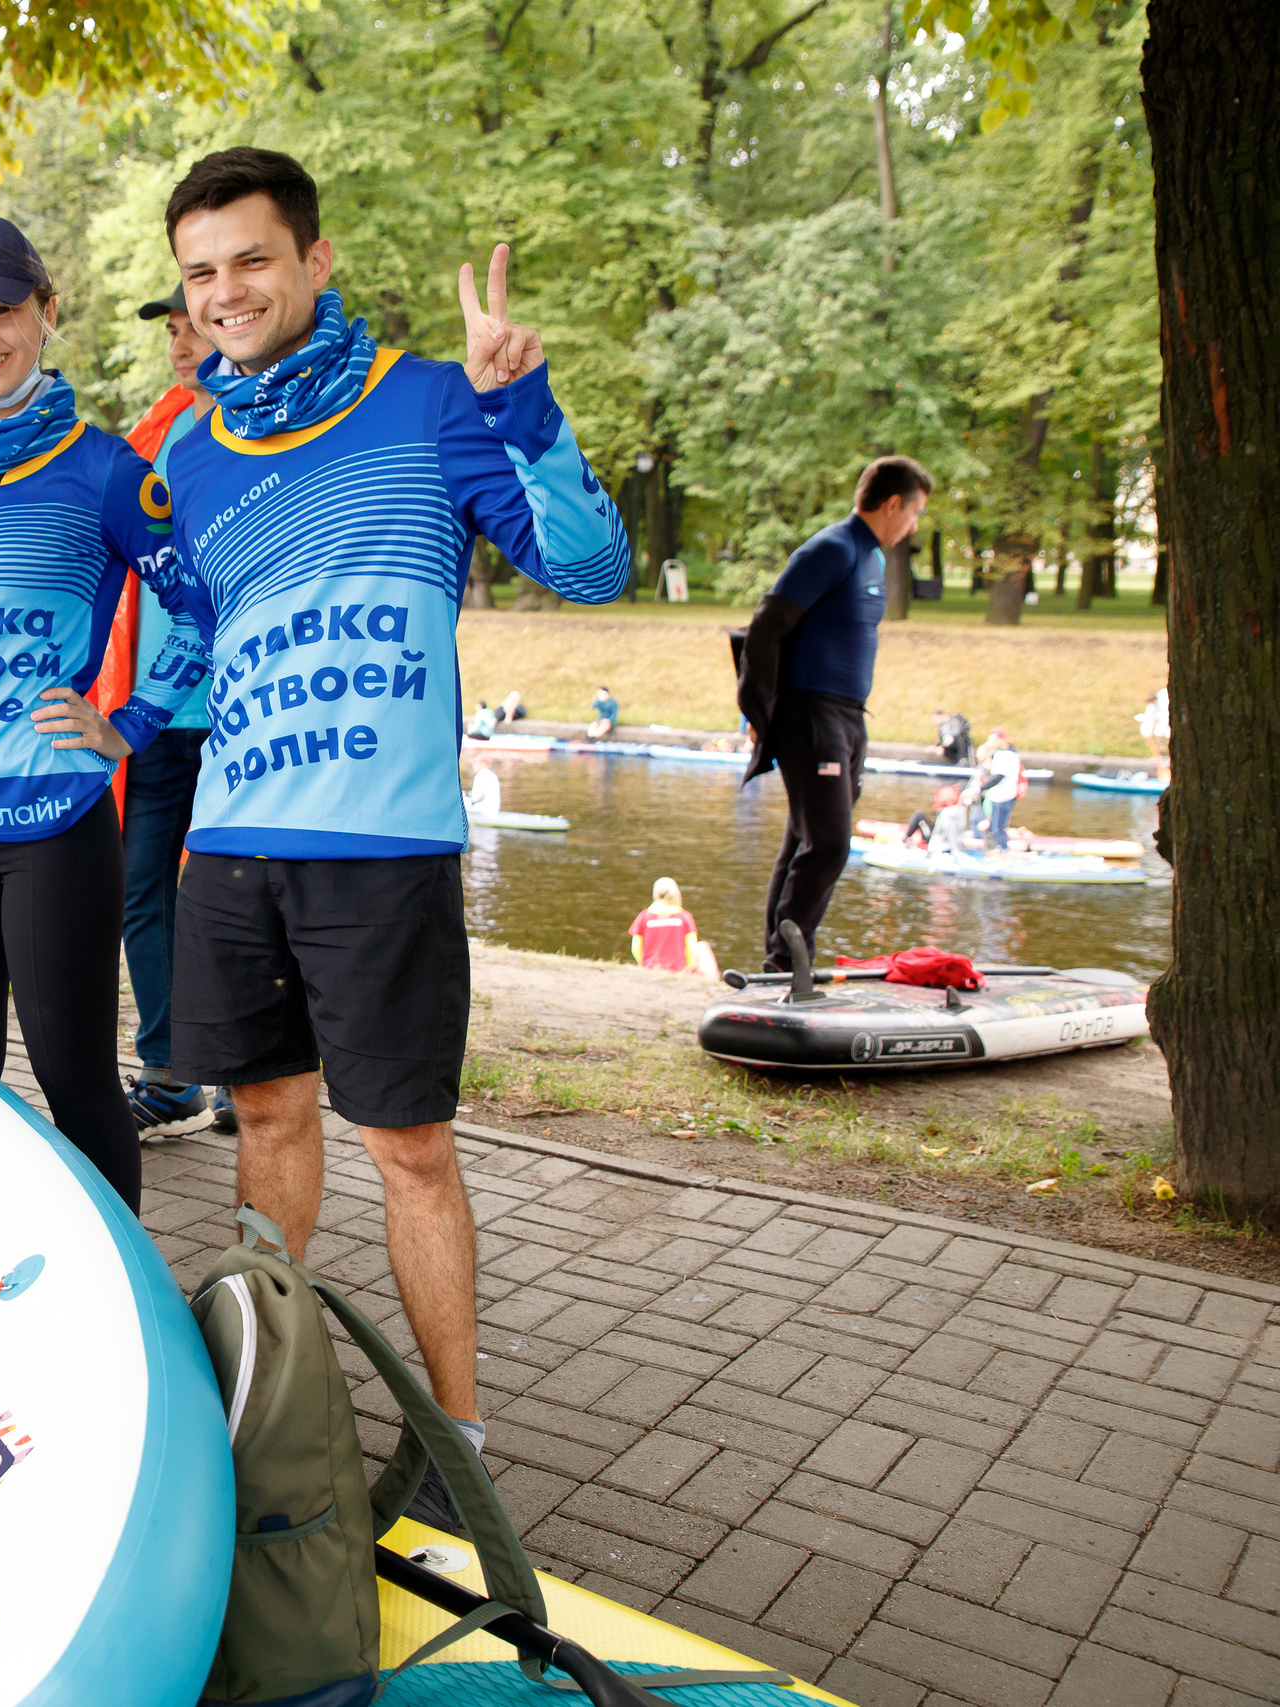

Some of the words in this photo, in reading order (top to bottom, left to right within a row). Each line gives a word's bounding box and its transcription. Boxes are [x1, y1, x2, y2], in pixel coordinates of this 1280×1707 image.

[208, 697, 251, 758] на
[251, 649, 427, 719] твоей
[224, 725, 378, 797] волне
